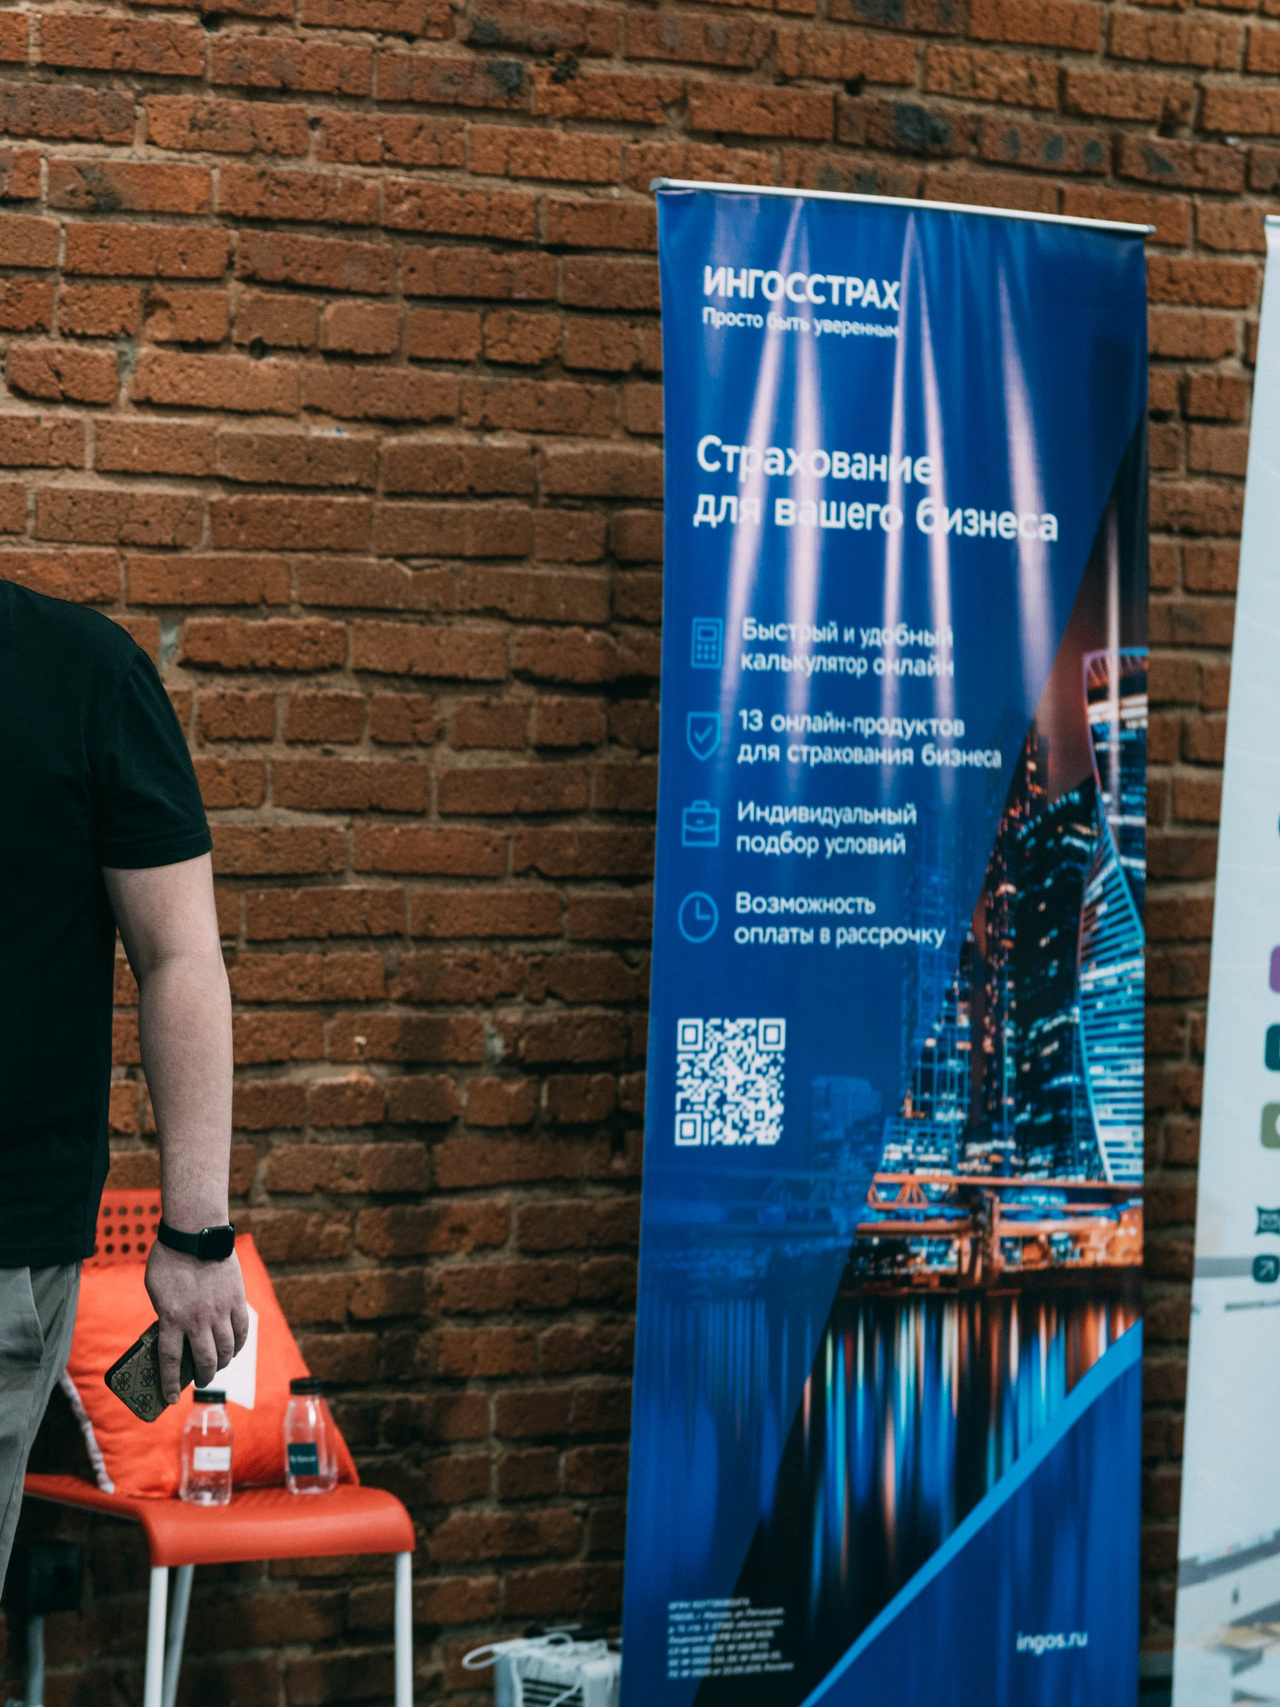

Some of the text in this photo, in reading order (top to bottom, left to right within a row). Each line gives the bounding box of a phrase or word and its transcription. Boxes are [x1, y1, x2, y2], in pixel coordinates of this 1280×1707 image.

[703, 265, 900, 311] ИНГОССТРАХ
[702, 306, 763, 330] Просто
[766, 312, 810, 331] быть
[696, 434, 935, 484] Страхование
[693, 494, 1059, 542] для вашего бизнеса
[742, 616, 953, 649] Быстрый и удобный
[741, 653, 954, 679] калькулятор онлайн
[738, 709, 965, 741] 13 онлайн-продуктов
[737, 741, 1002, 769] для страхования бизнеса
[737, 800, 917, 829] Индивидуальный
[736, 830, 906, 859] подбор условий
[735, 891, 876, 914] Возможность
[734, 926, 946, 949] оплаты в рассрочку
[1016, 1630, 1088, 1656] ingos.ru
